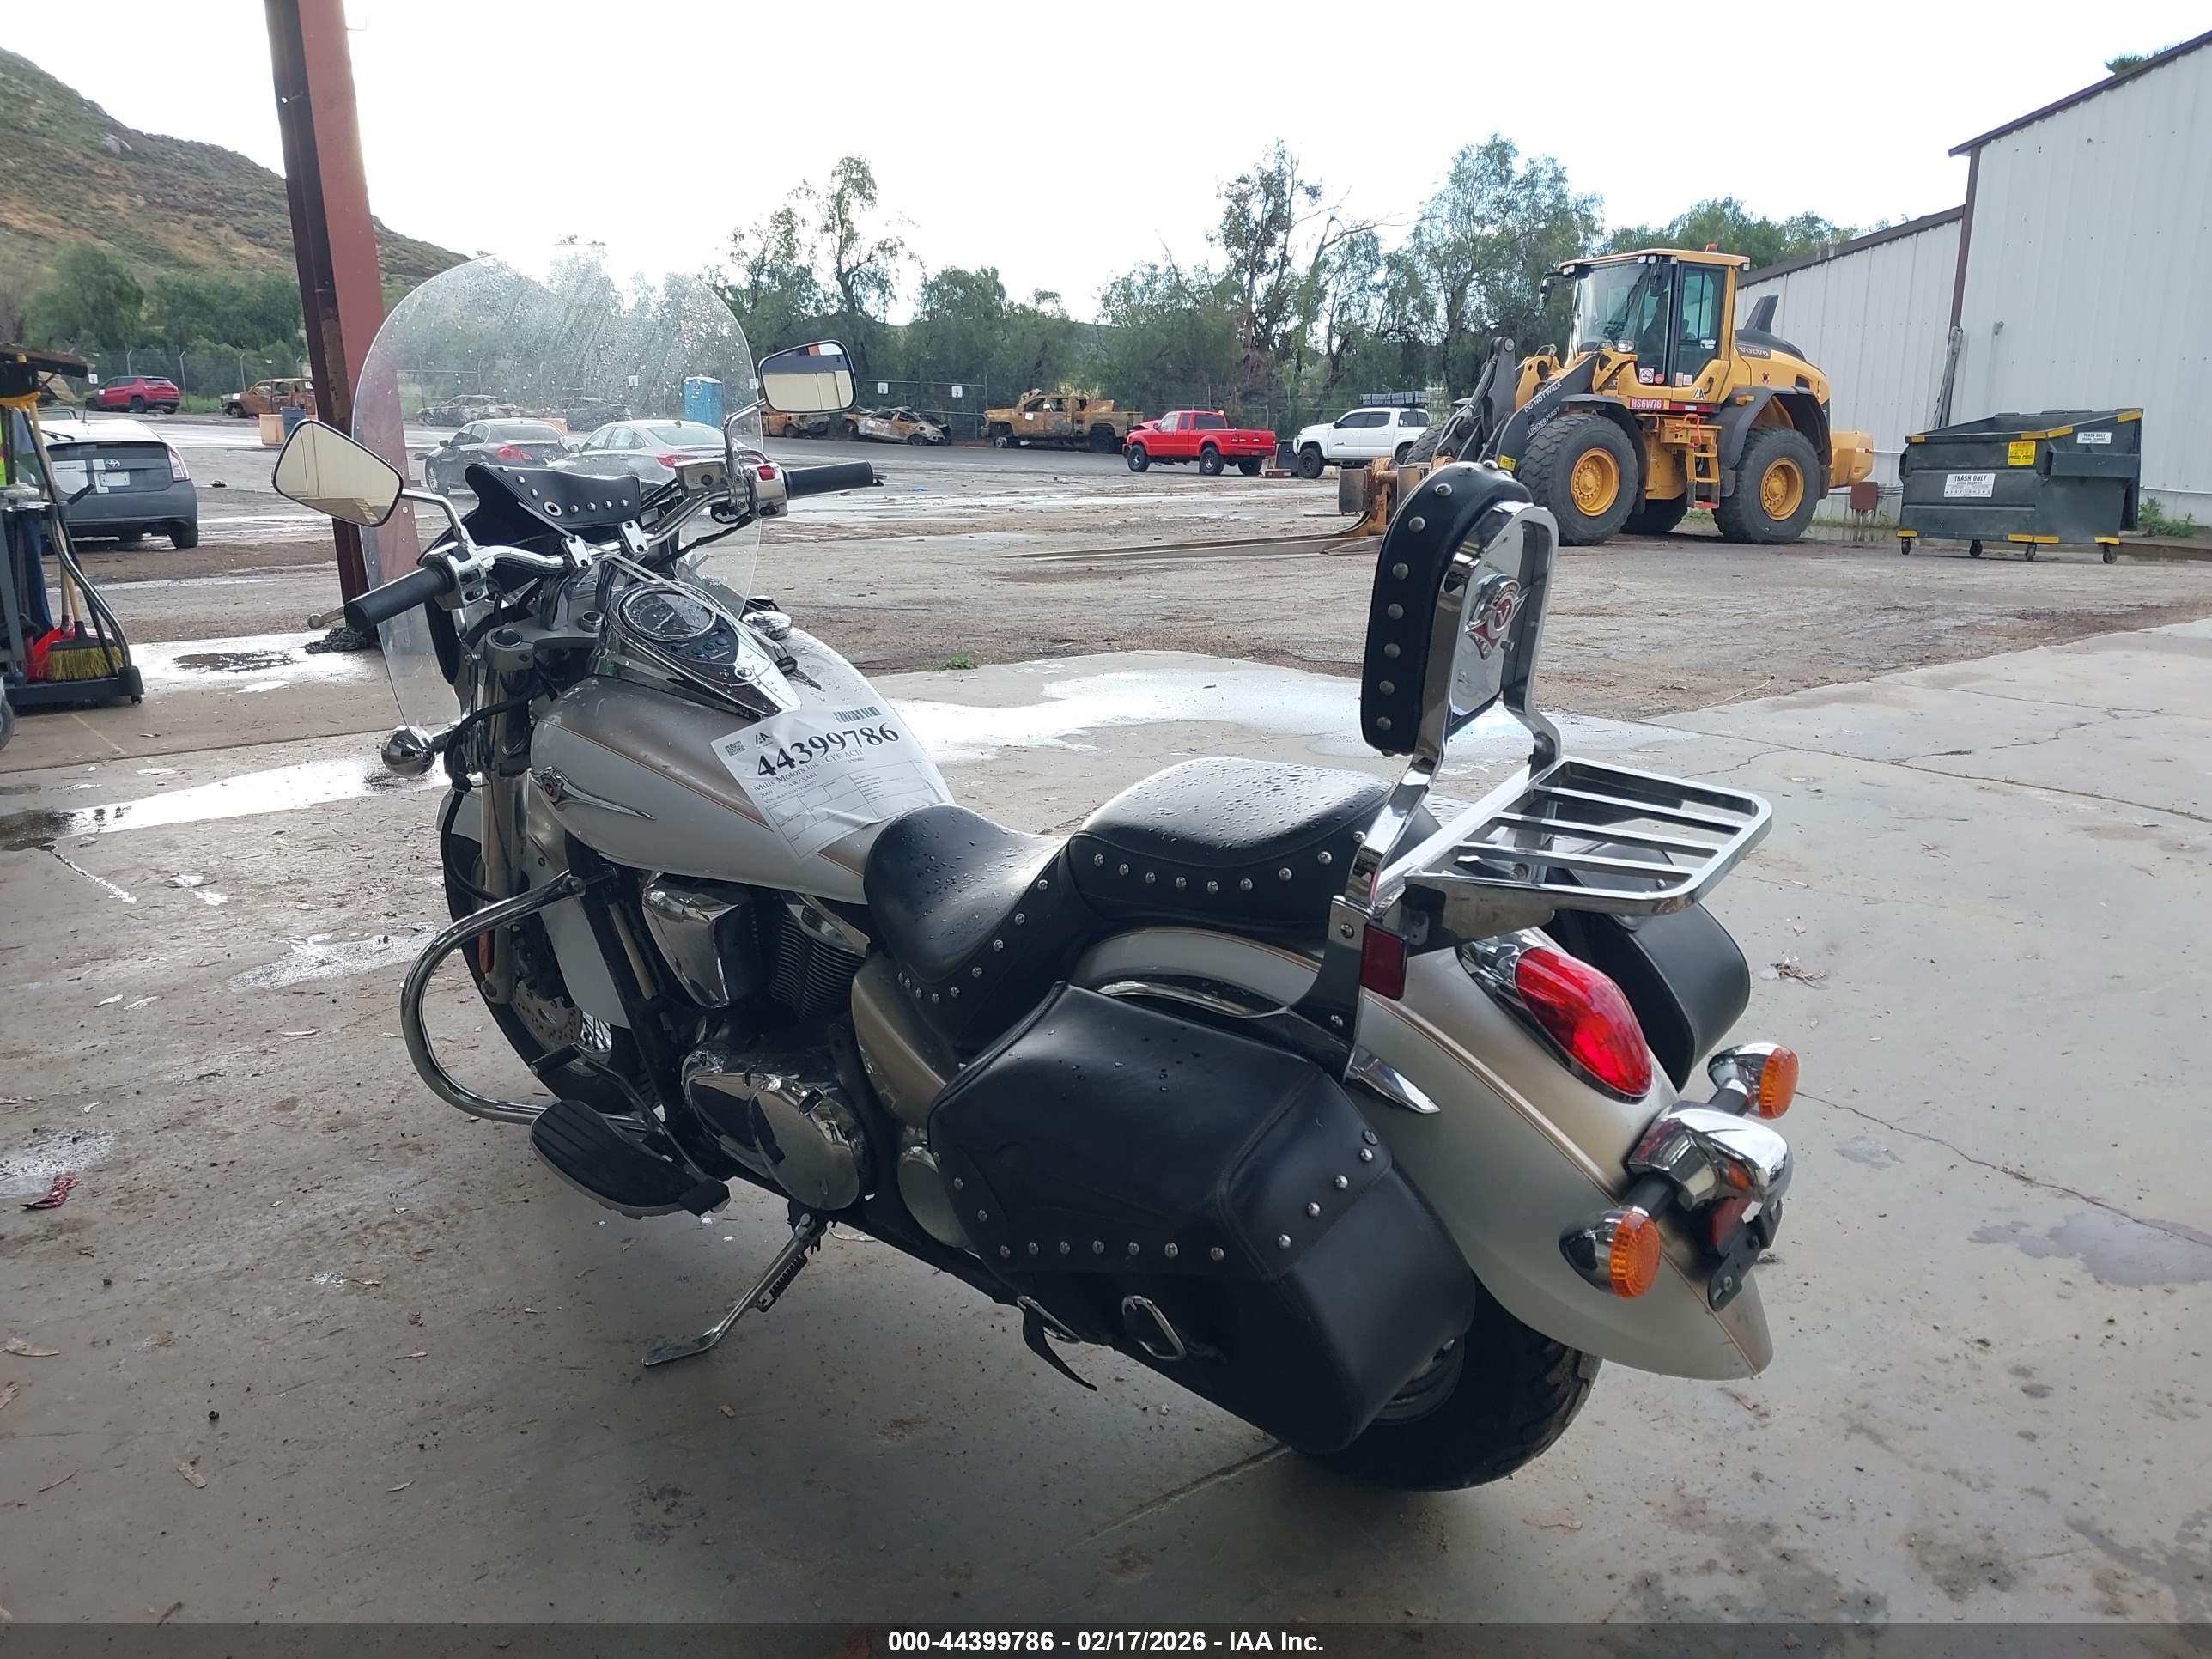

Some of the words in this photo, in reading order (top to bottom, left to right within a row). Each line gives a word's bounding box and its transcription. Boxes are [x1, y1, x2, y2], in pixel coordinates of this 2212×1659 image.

[1738, 346, 1769, 356] VOLVO
[1524, 404, 1534, 413] DO
[1534, 392, 1547, 405] NOT
[1545, 382, 1562, 397] WALK
[1528, 418, 1547, 435] UNDER
[1546, 406, 1561, 422] MAST
[757, 722, 900, 777] 44399786
[753, 781, 775, 792] Mills
[775, 769, 805, 784] Motors
